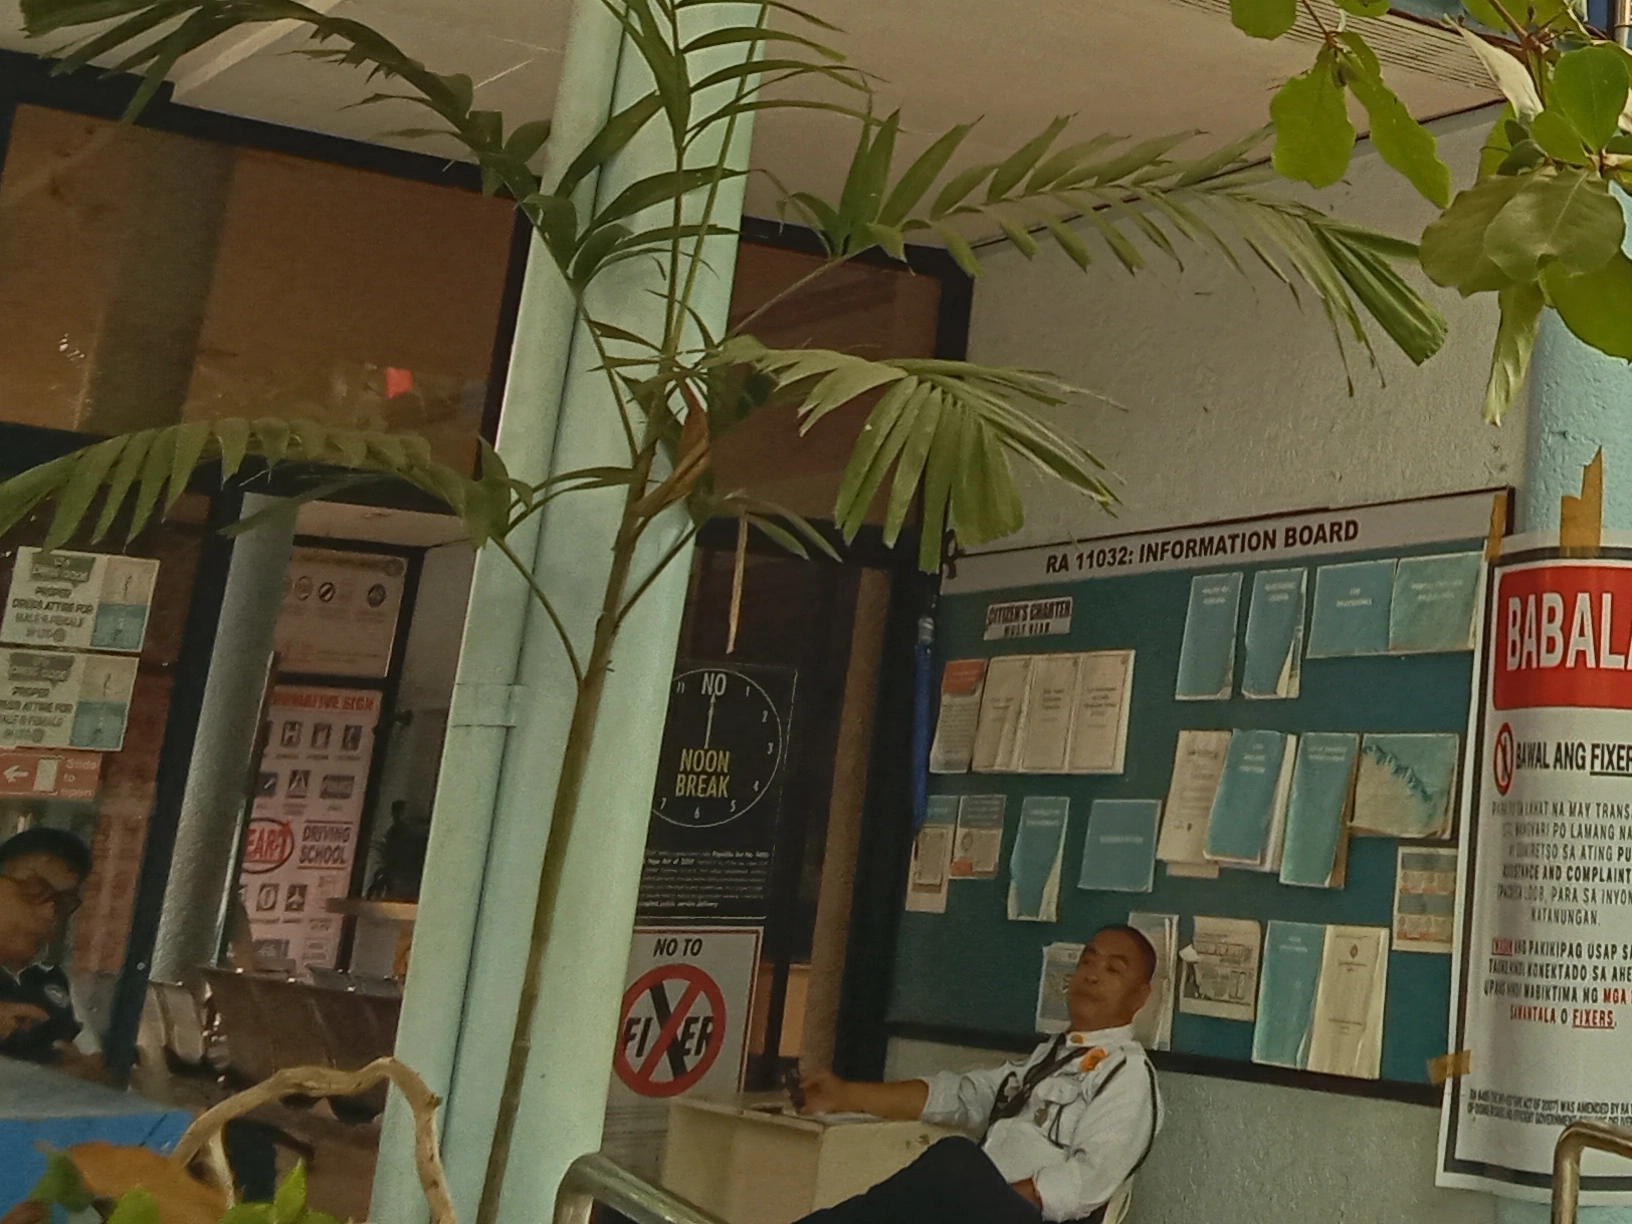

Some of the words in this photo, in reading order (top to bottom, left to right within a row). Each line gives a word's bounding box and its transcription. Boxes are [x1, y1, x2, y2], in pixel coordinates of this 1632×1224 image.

[1045, 552, 1070, 575] RA
[1076, 546, 1134, 572] 11032:
[1138, 528, 1278, 565] INFORMATION
[1283, 519, 1360, 550] BOARD
[701, 672, 727, 696] NO
[761, 709, 769, 723] 2
[766, 741, 774, 755] 3
[1515, 741, 1550, 770] BAWAL
[1553, 741, 1587, 771] ANG
[679, 747, 731, 774] NOON
[63, 772, 77, 783] to
[674, 773, 731, 799] BREAK
[693, 806, 701, 820] 6
[1552, 801, 1565, 817] NA
[1568, 801, 1590, 819] MAY
[302, 826, 351, 844] DRIVING
[1552, 823, 1567, 839] PO
[1570, 824, 1615, 841] LAMANG
[1619, 825, 1632, 842] NA
[300, 844, 346, 864] SCHOOL
[1562, 843, 1577, 861] SA
[1580, 844, 1613, 862] ATING
[1542, 865, 1563, 882] AND
[1566, 865, 1632, 885] COMPLAINT
[1551, 885, 1579, 904] PARA
[1582, 887, 1598, 905] SA
[1531, 907, 1601, 927] KATANUNGAN.
[652, 937, 679, 958] NO
[683, 937, 704, 957] TO
[1528, 940, 1583, 959] PAKIKIPAG
[1587, 942, 1618, 960] USAP
[1527, 962, 1588, 980] KONEKTADO
[1592, 965, 1607, 982] SA
[1523, 983, 1578, 1003] MABIKTIMA
[1582, 986, 1599, 1004] NG
[1602, 987, 1627, 1005] MGA
[1510, 1005, 1557, 1024] SAMANTALA
[1560, 1008, 1568, 1024] O
[1572, 1008, 1617, 1028] FIXERS.
[1560, 1099, 1576, 1114] WAS
[1576, 1100, 1609, 1115] AMENDED
[1610, 1101, 1620, 1116] BY
